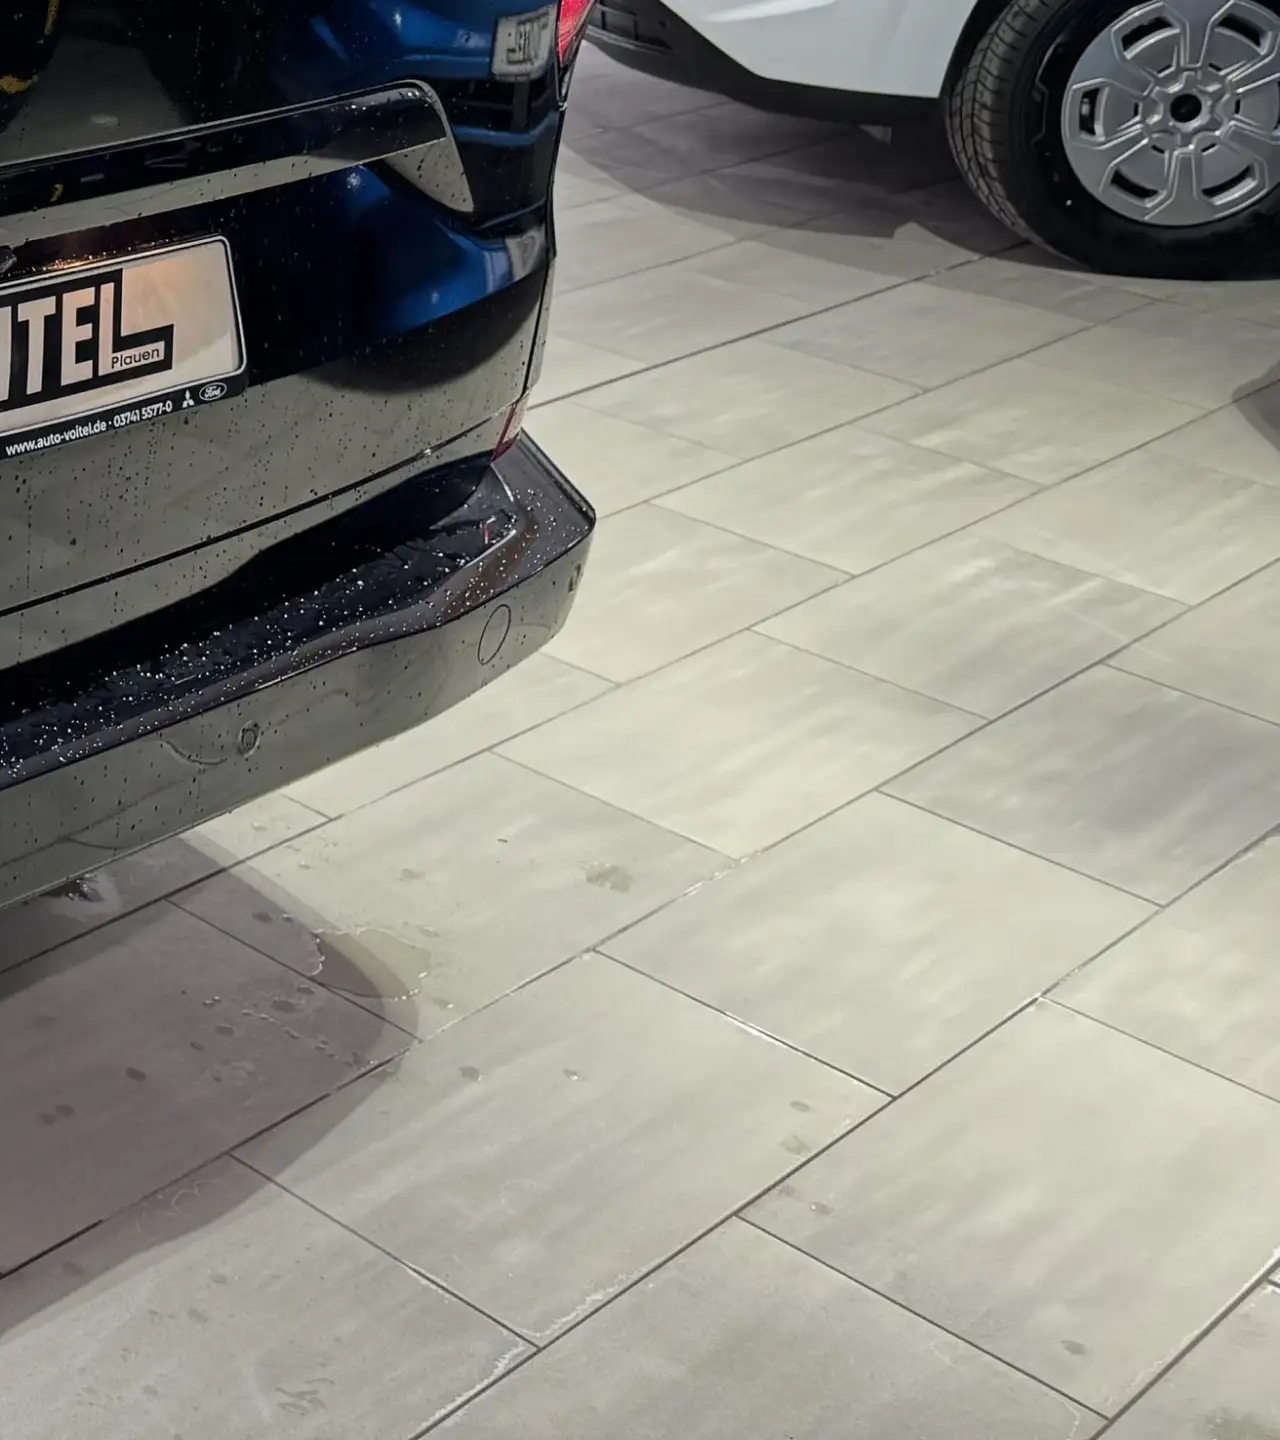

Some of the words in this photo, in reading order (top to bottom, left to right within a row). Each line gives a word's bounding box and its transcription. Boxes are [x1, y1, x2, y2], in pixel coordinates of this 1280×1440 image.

[110, 345, 161, 371] Plauen
[5, 420, 107, 457] www.auto-voitel.de
[113, 408, 141, 429] 03741
[141, 400, 173, 421] 5577-0
